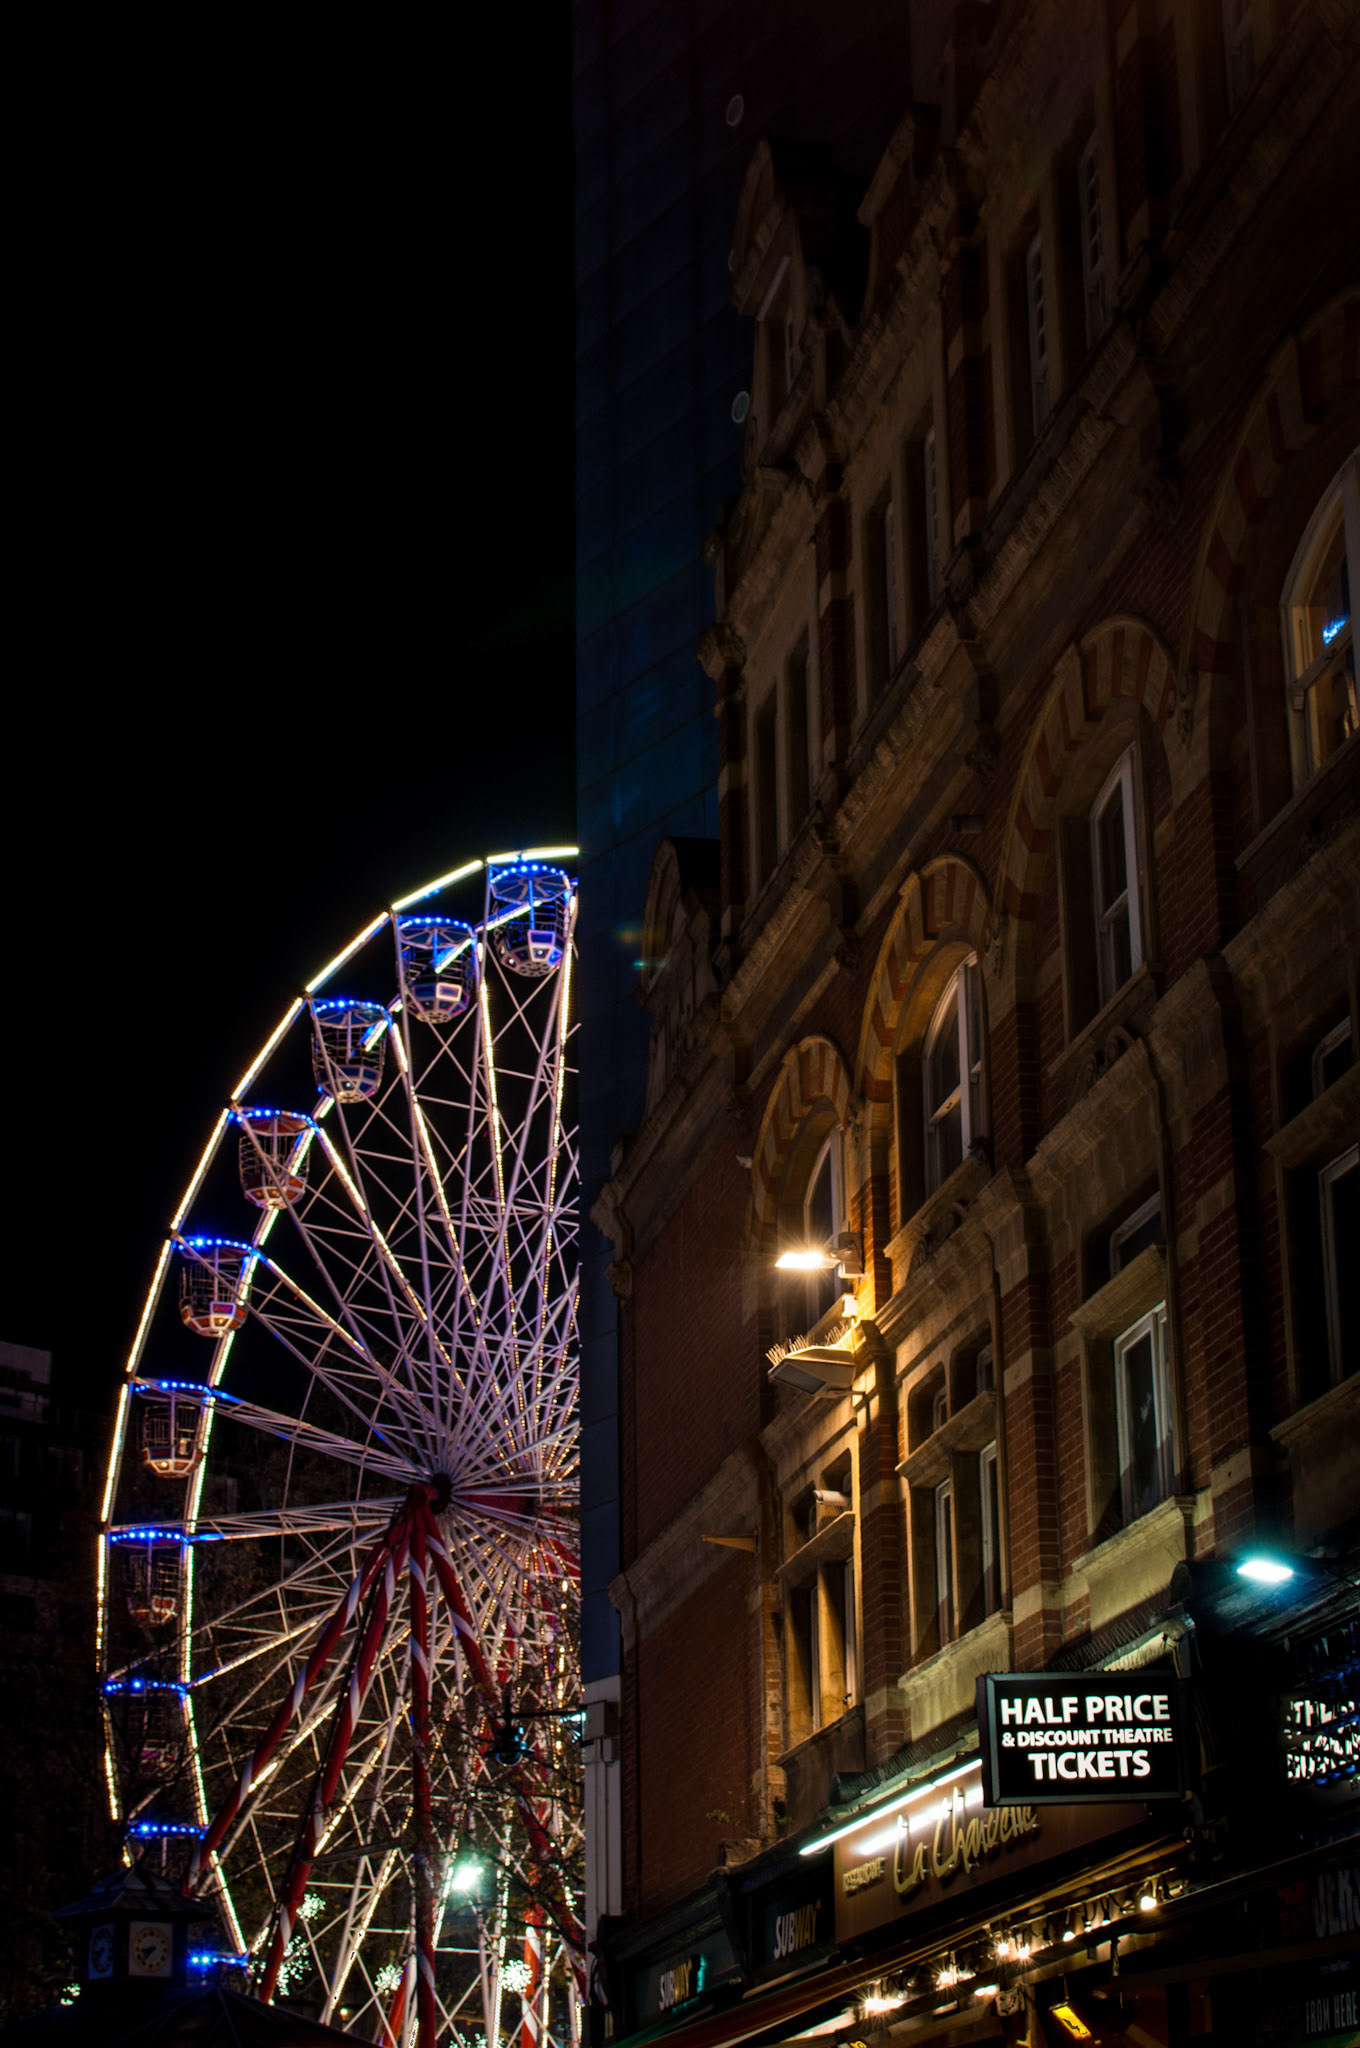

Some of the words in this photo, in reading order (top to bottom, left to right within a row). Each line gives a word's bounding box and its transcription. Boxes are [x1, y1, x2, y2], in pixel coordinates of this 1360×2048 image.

[1001, 1697, 1078, 1725] HALF
[1085, 1694, 1171, 1722] PRICE
[1002, 1732, 1016, 1748] &
[1017, 1729, 1101, 1747] DISCOUNT
[1102, 1727, 1174, 1745] THEATRE
[1028, 1749, 1151, 1780] TICKETS
[893, 1814, 926, 1894] La
[773, 1897, 823, 1960] SUBWAY
[659, 1954, 694, 2012] SUBWAY
[1306, 1996, 1331, 2036] FROM
[1333, 1990, 1360, 2030] HERE
